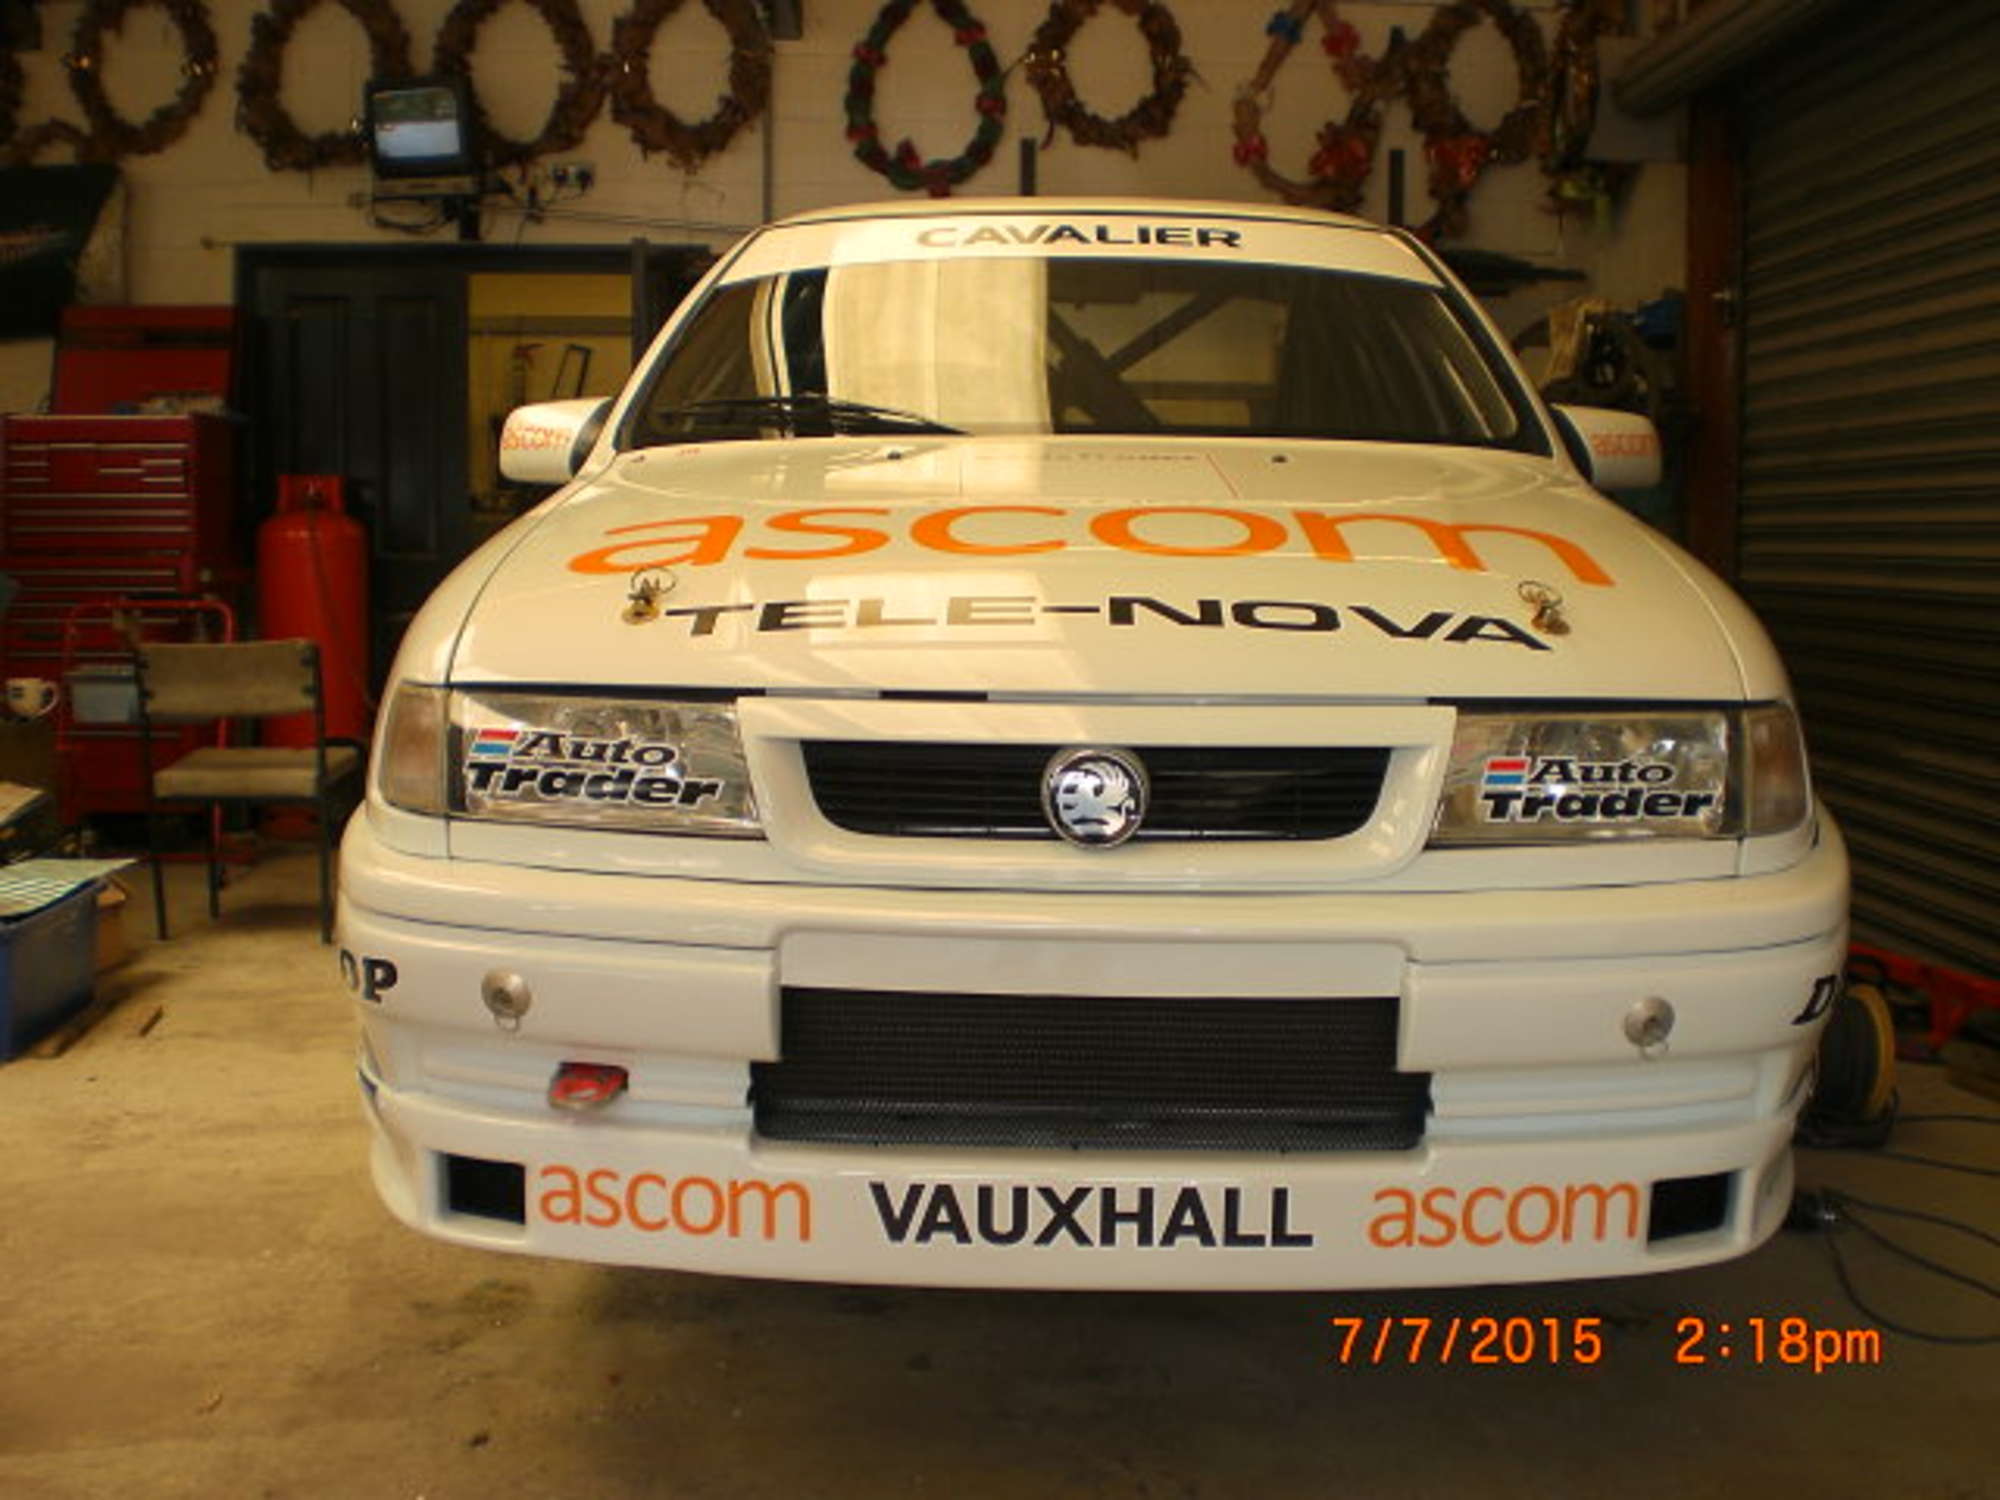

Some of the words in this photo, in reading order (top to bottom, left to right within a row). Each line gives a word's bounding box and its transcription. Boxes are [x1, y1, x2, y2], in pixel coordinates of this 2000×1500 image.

[916, 224, 1242, 248] CAVALIER
[567, 504, 1617, 588] ascom
[665, 596, 1553, 652] TELE-NOVA
[512, 730, 677, 768] Auto
[1529, 757, 1675, 784] Auto
[466, 761, 723, 805] Trader
[1482, 787, 1715, 821] Trader
[540, 1164, 812, 1242] ascom
[869, 1181, 1314, 1248] VAUXHALL
[1368, 1181, 1640, 1248] ascom
